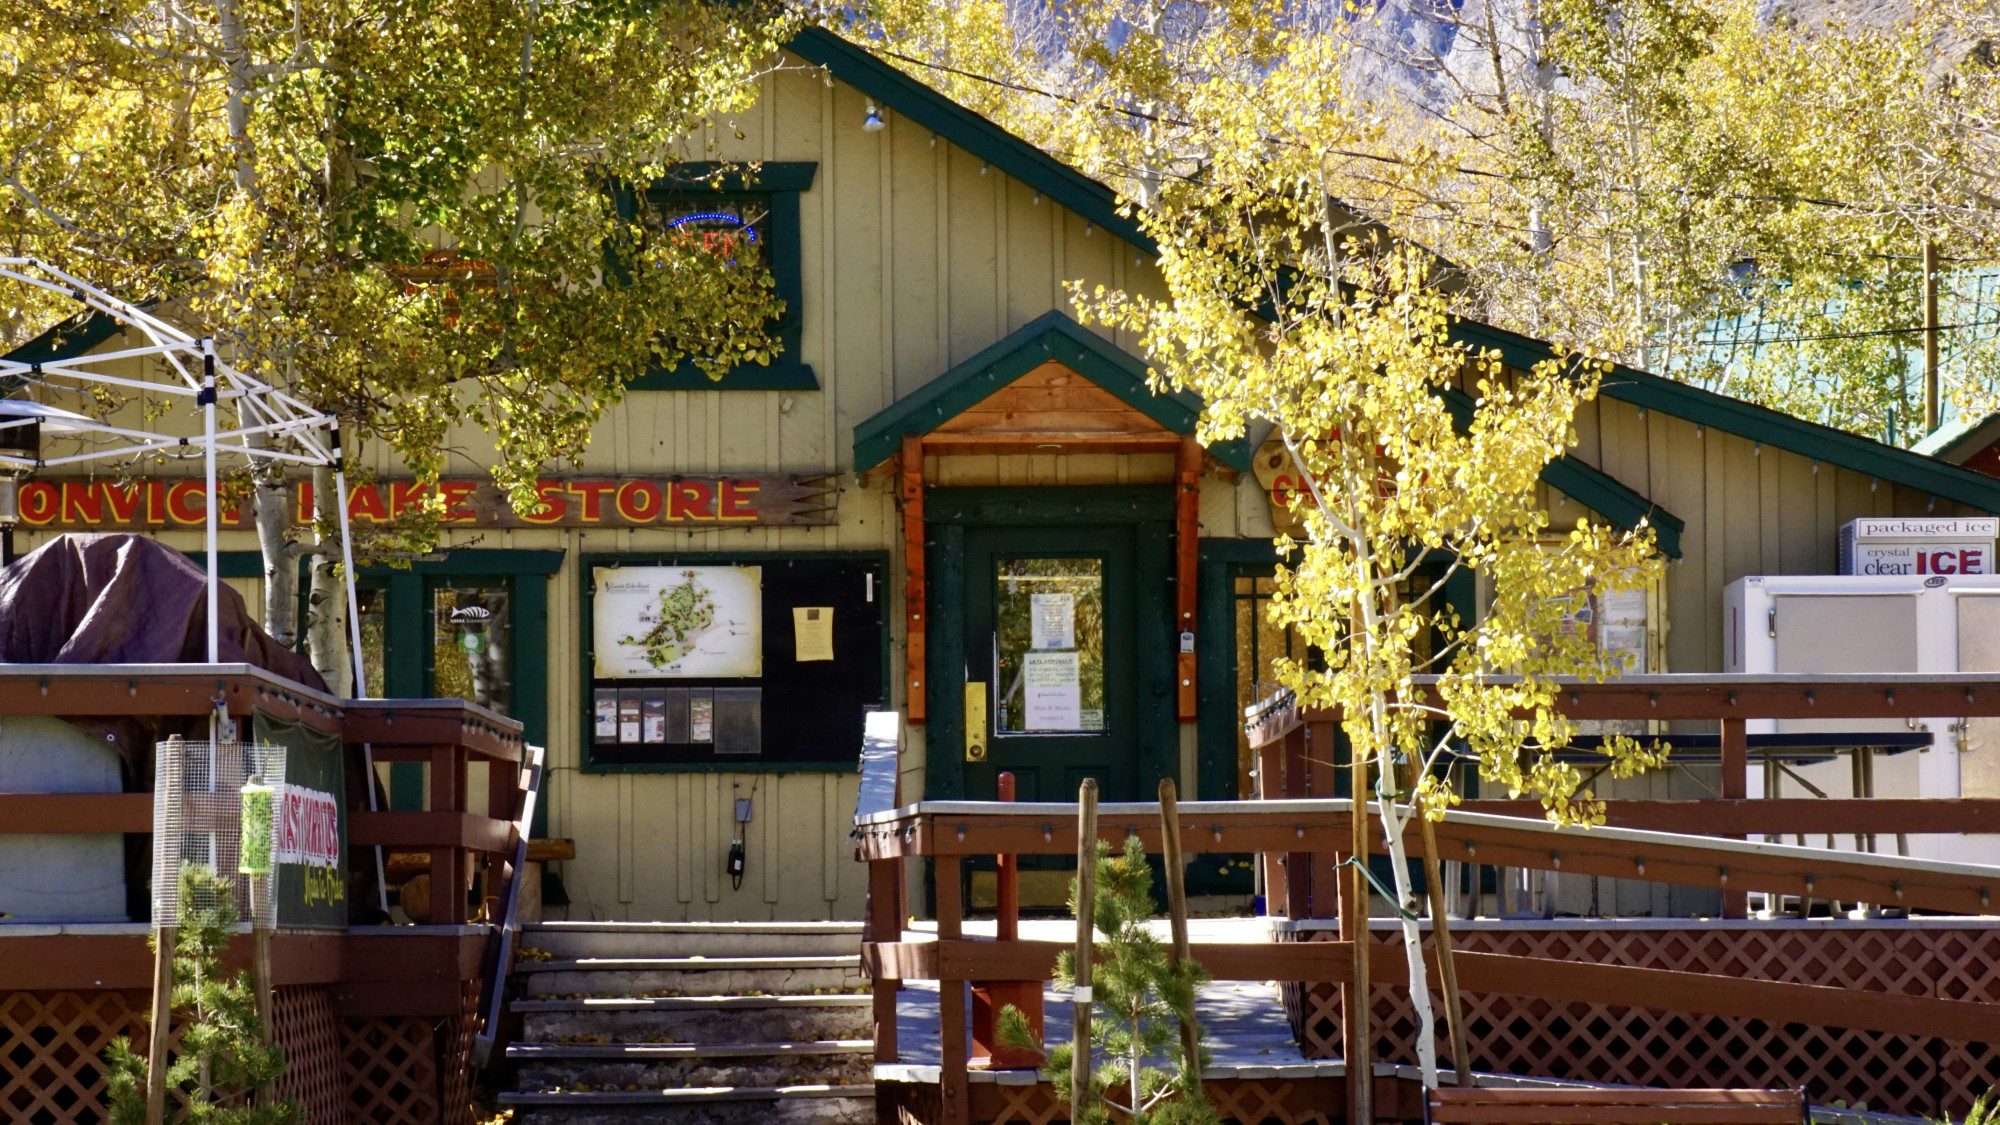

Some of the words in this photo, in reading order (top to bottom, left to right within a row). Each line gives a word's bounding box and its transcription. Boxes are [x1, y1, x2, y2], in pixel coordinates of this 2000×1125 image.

[18, 480, 254, 525] ONVICT
[518, 480, 760, 524] STORE
[1866, 521, 1957, 535] packaged
[1965, 521, 1992, 533] ice
[1867, 547, 1910, 559] crystal
[1916, 547, 1983, 575] ICE
[1864, 558, 1912, 575] clear
